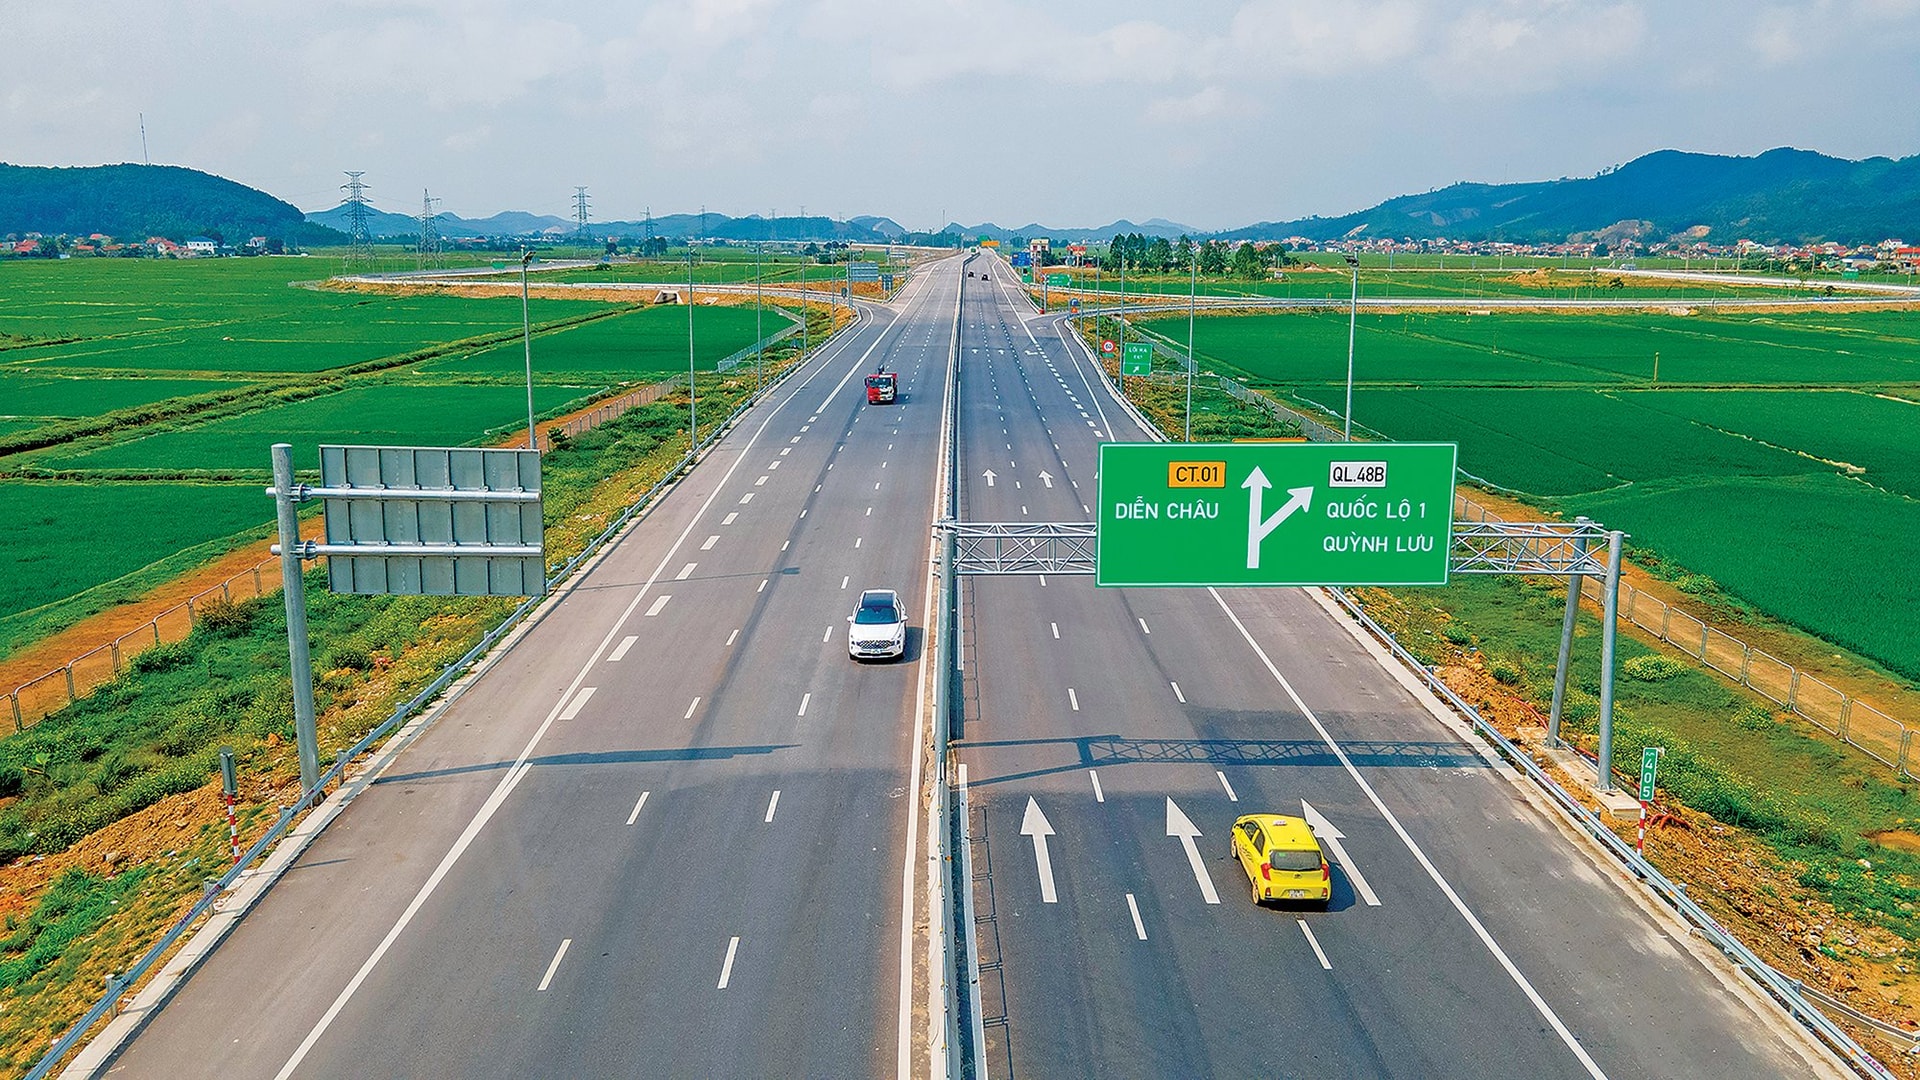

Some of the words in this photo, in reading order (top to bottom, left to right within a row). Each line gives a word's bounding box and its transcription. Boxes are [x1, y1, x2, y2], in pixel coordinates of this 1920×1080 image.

[1175, 466, 1218, 483] CT.01
[1332, 466, 1385, 484] QL.48B
[1115, 495, 1159, 519] DIỄN
[1166, 498, 1219, 519] CHÂU
[1326, 494, 1378, 519] QUỐC
[1386, 498, 1411, 522] LỘ
[1419, 502, 1426, 519] 1
[1323, 531, 1388, 553] QUỲNH
[1396, 533, 1434, 552] LƯU
